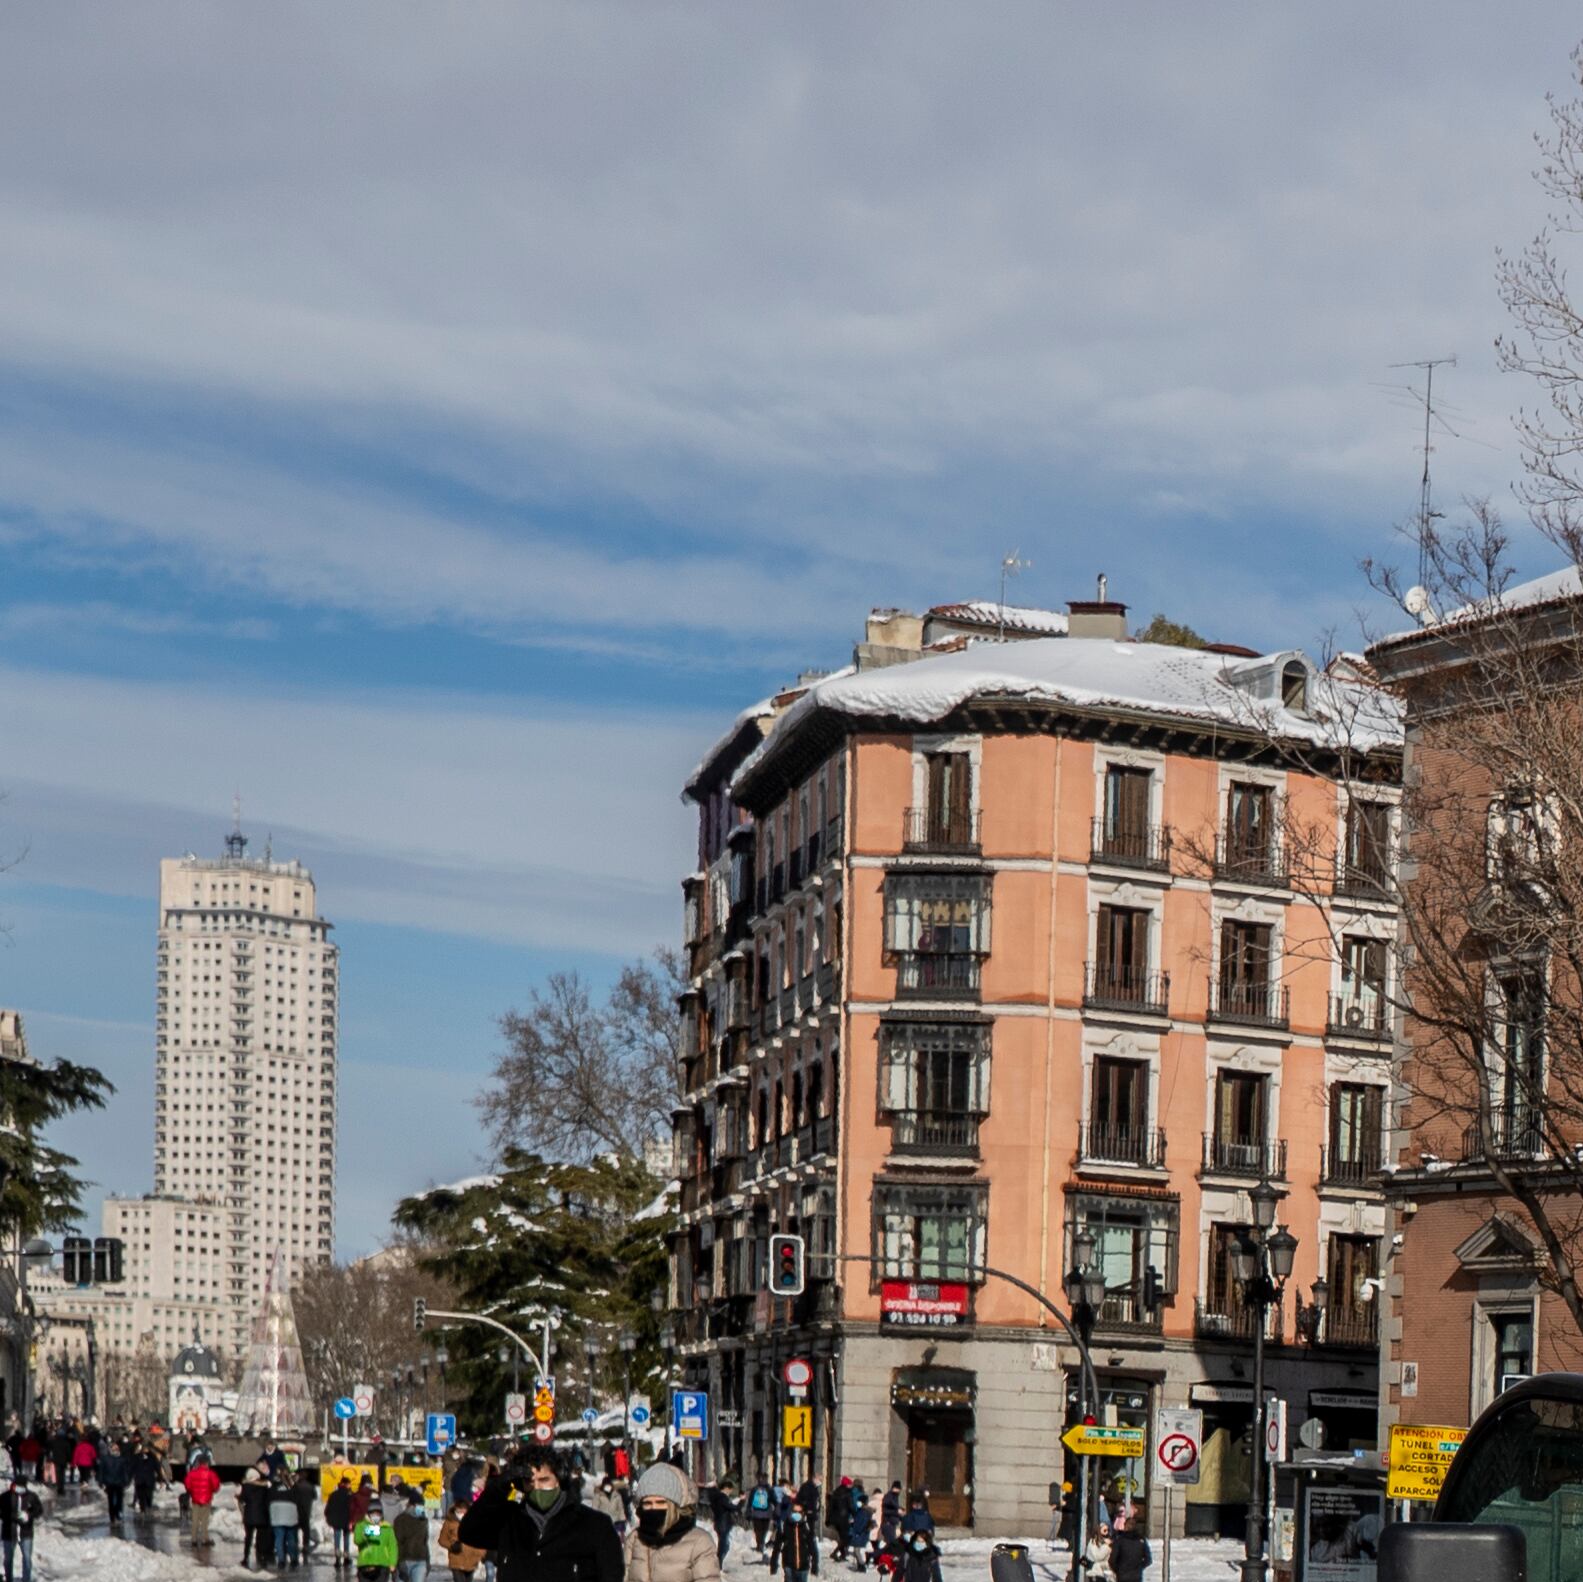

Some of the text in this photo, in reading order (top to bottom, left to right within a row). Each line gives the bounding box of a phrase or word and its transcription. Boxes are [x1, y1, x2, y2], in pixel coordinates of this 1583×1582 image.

[683, 1396, 697, 1414] P
[1412, 1452, 1454, 1461] CORTAD
[1398, 1465, 1438, 1474] ACCESO
